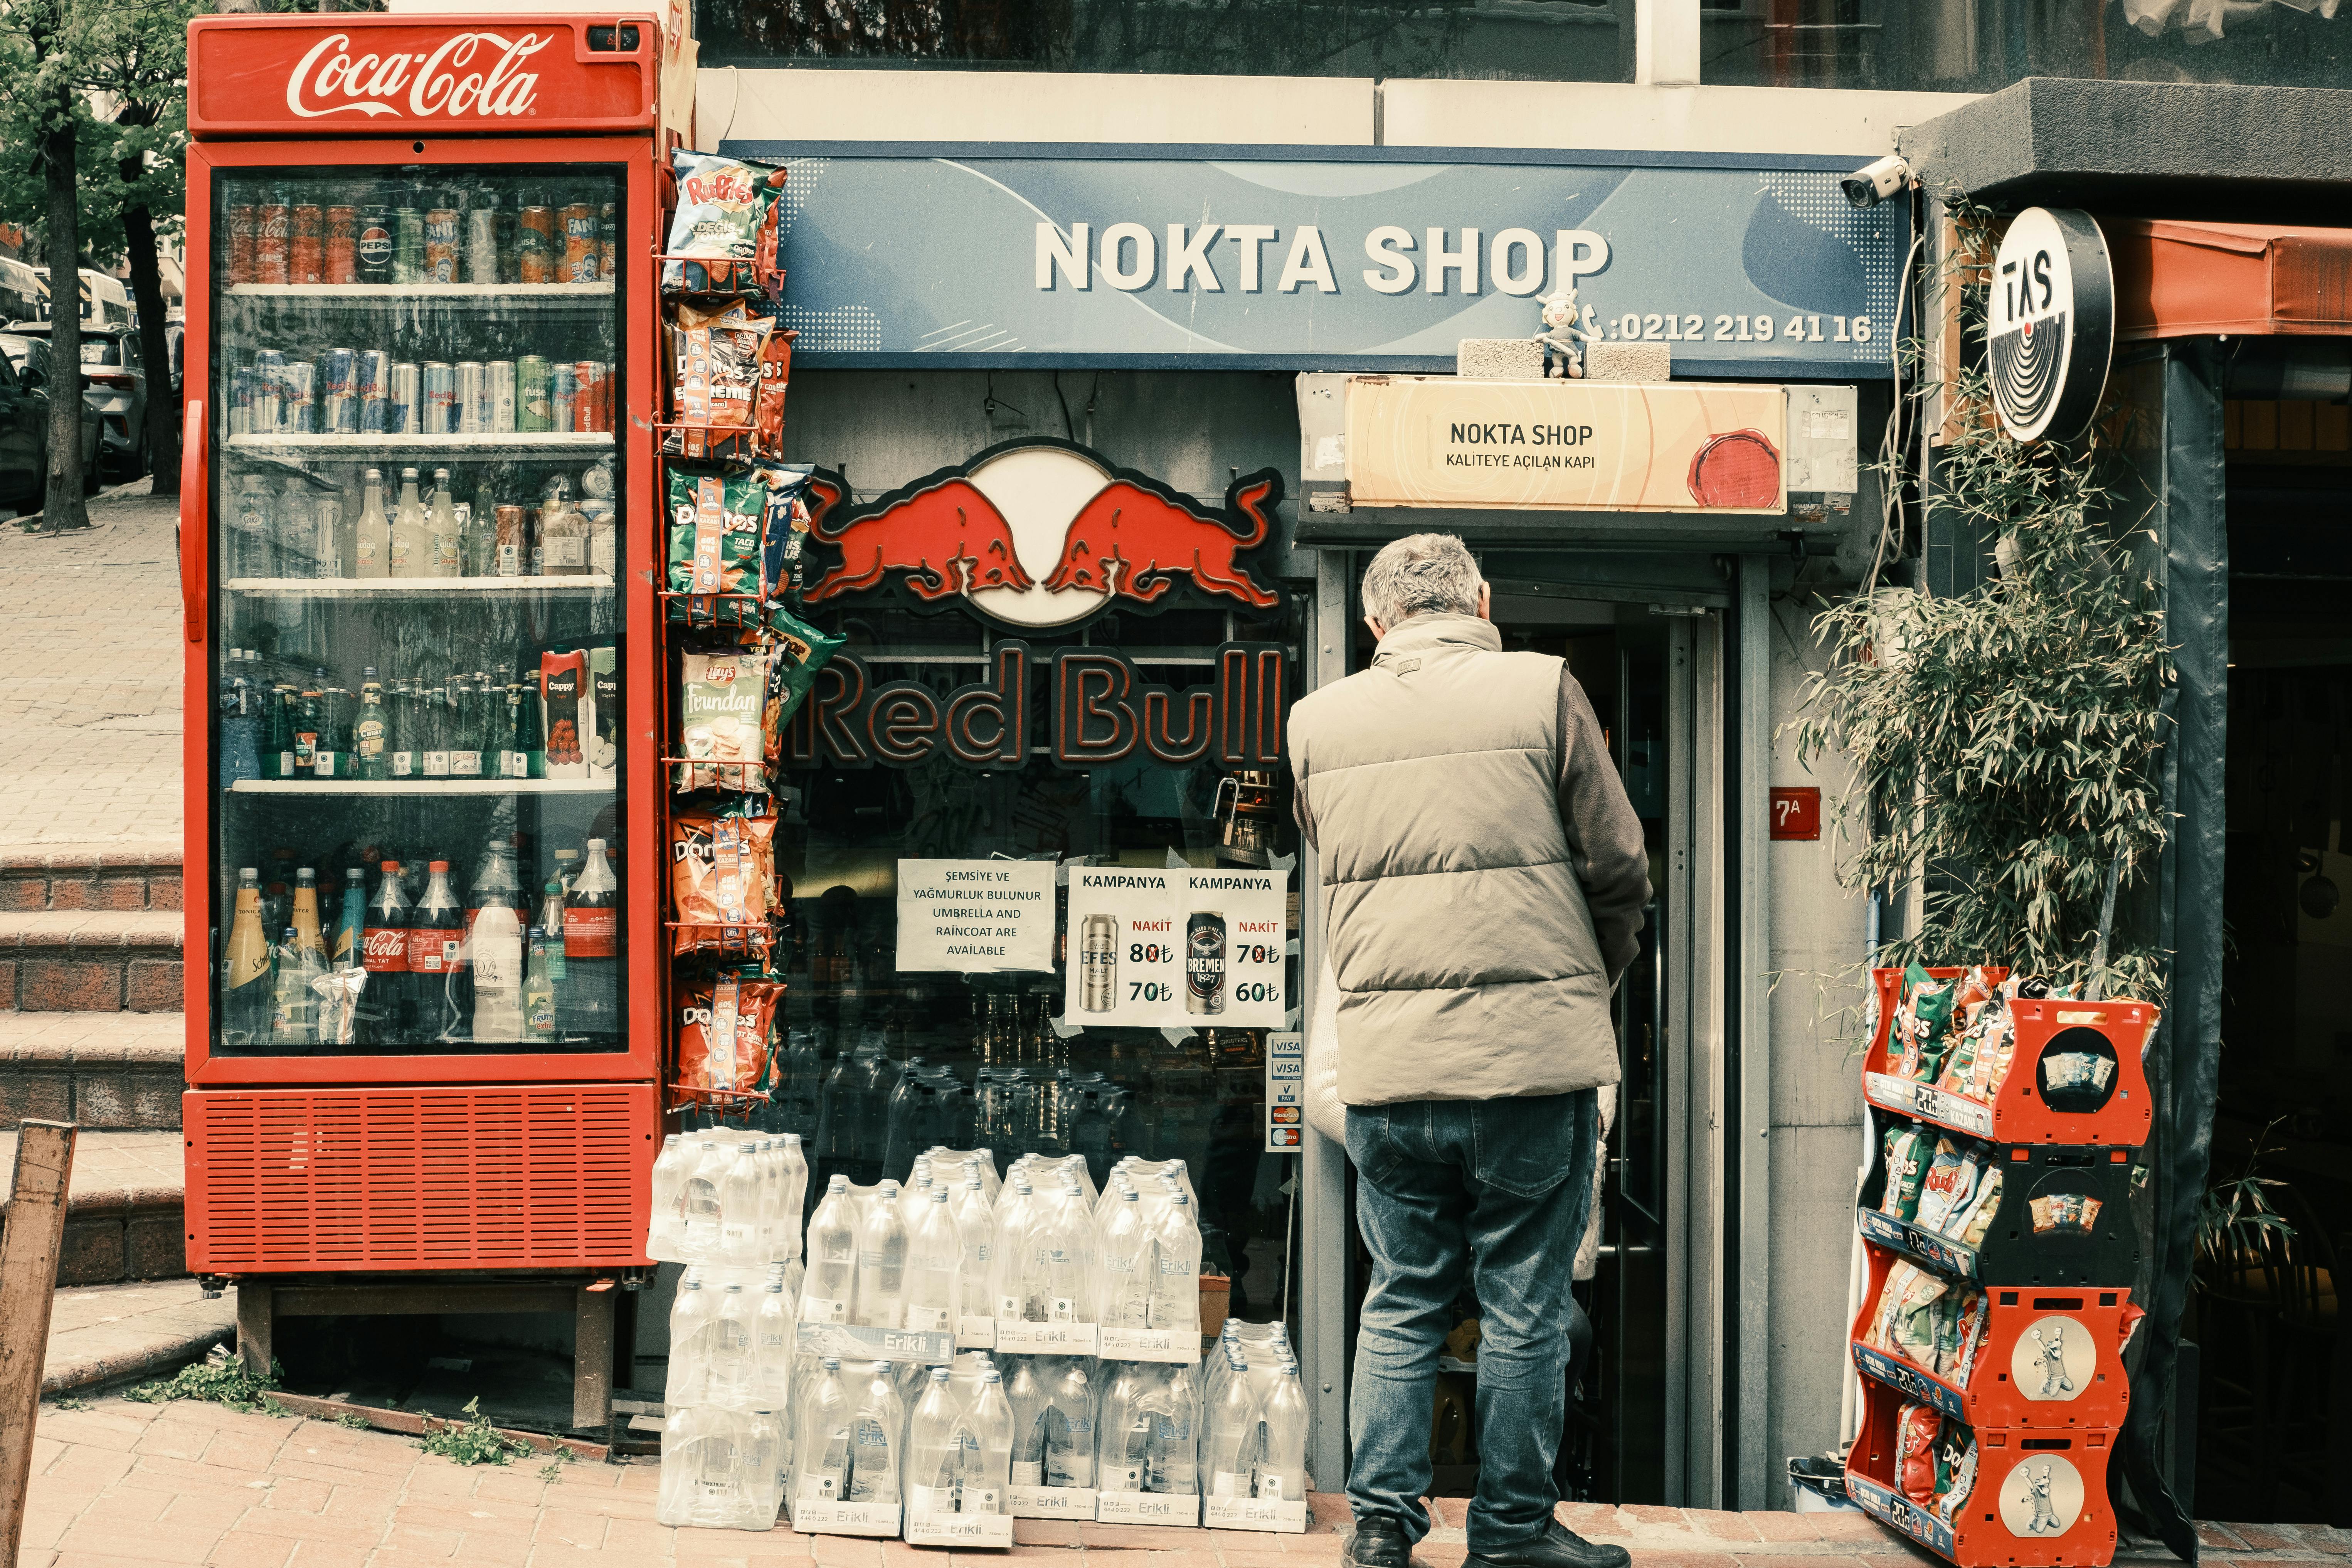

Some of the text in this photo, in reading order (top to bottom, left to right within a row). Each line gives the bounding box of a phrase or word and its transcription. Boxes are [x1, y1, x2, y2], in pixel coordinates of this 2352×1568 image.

[287, 33, 554, 118] Coca-Cola
[686, 174, 753, 207] Ruffles
[361, 241, 390, 250] PEPSI
[1035, 222, 1608, 295] NOKTA SHOP
[1714, 315, 1773, 341] 219
[1784, 316, 1824, 341] 41
[1834, 315, 1871, 342] 16
[524, 386, 546, 397] fuse
[1451, 423, 1593, 446] NOKTA SHOP
[1447, 451, 1594, 470] KALİTEYE AÇILAN KAPI
[734, 537, 755, 547] TACO
[707, 664, 735, 680] Lay's
[548, 682, 574, 691] Cappy
[793, 647, 1282, 762] Red Bull
[361, 729, 382, 737] Cmax
[1776, 800, 1800, 826] 7A
[946, 869, 1009, 883] ŞEMSİYE VE
[1083, 875, 1166, 889] KAMPANYA
[1189, 877, 1272, 890] KAMPANYA
[913, 887, 1041, 900] YAĞMURLUK BULUNUR
[933, 908, 1021, 918] UMBRELLA AND
[936, 925, 1017, 937] RAİNCOAT ARE
[1133, 921, 1172, 931] NAKİT
[1239, 920, 1278, 932] NAKİT
[947, 943, 1005, 955] AVAİLABLE
[1082, 951, 1117, 965] EFES
[1188, 958, 1224, 972] BREMEN
[1197, 972, 1215, 984] 1827
[1276, 1042, 1300, 1051] VISA
[1276, 1064, 1300, 1073] VISA
[1950, 1109, 1976, 1130] KAZAN!
[1037, 1495, 1067, 1508] Erikli
